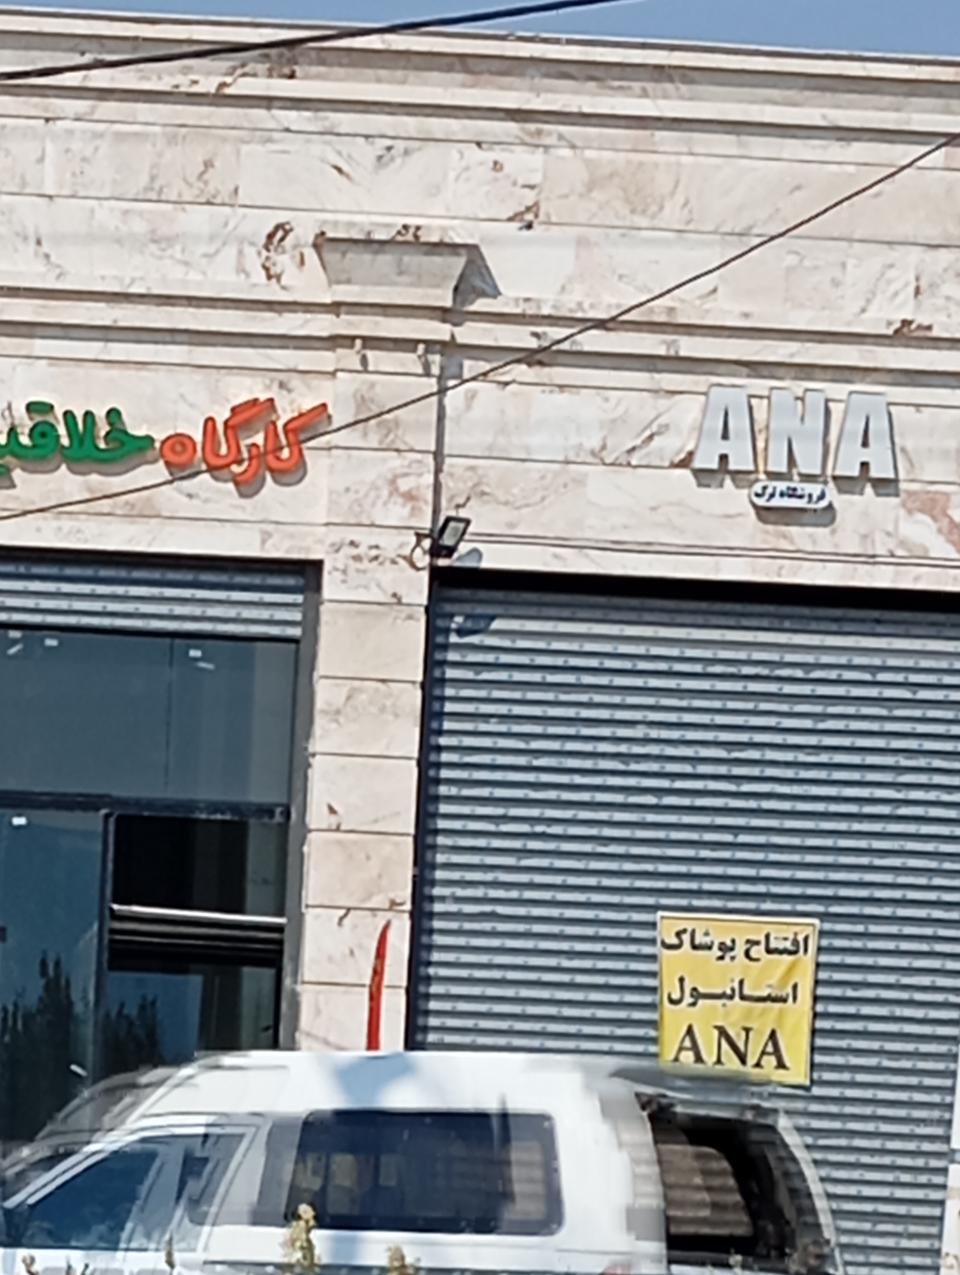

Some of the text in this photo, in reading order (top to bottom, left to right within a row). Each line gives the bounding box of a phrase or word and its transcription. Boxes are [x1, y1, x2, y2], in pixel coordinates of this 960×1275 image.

[160, 397, 328, 485] کارگاه
[692, 384, 897, 479] ANA
[660, 928, 736, 961] پوشاک
[667, 975, 799, 1007] استانبول
[672, 1023, 790, 1070] ANA
